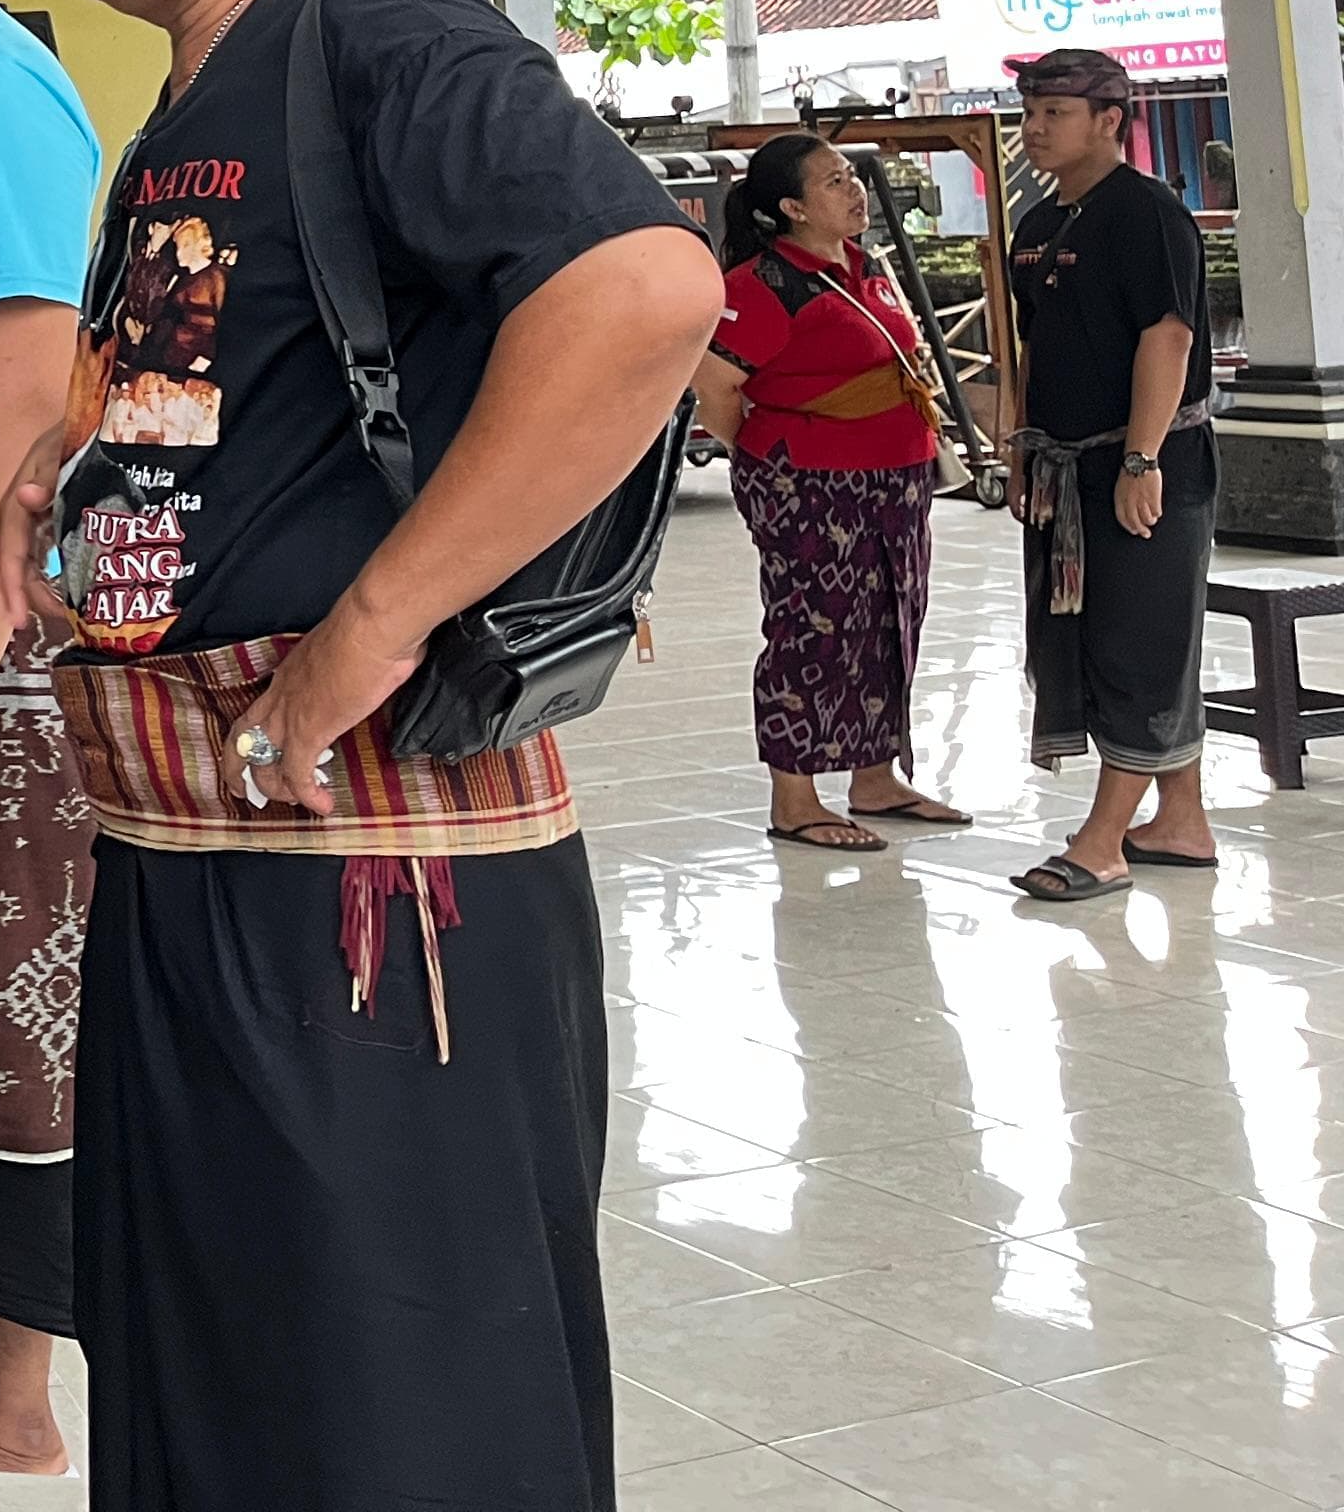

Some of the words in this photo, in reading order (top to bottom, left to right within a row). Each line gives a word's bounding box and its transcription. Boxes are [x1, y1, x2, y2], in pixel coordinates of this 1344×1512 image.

[1112, 49, 1156, 66] ANG
[1165, 44, 1222, 64] BATU
[86, 509, 180, 545] PUTRA
[95, 550, 179, 583] ANG
